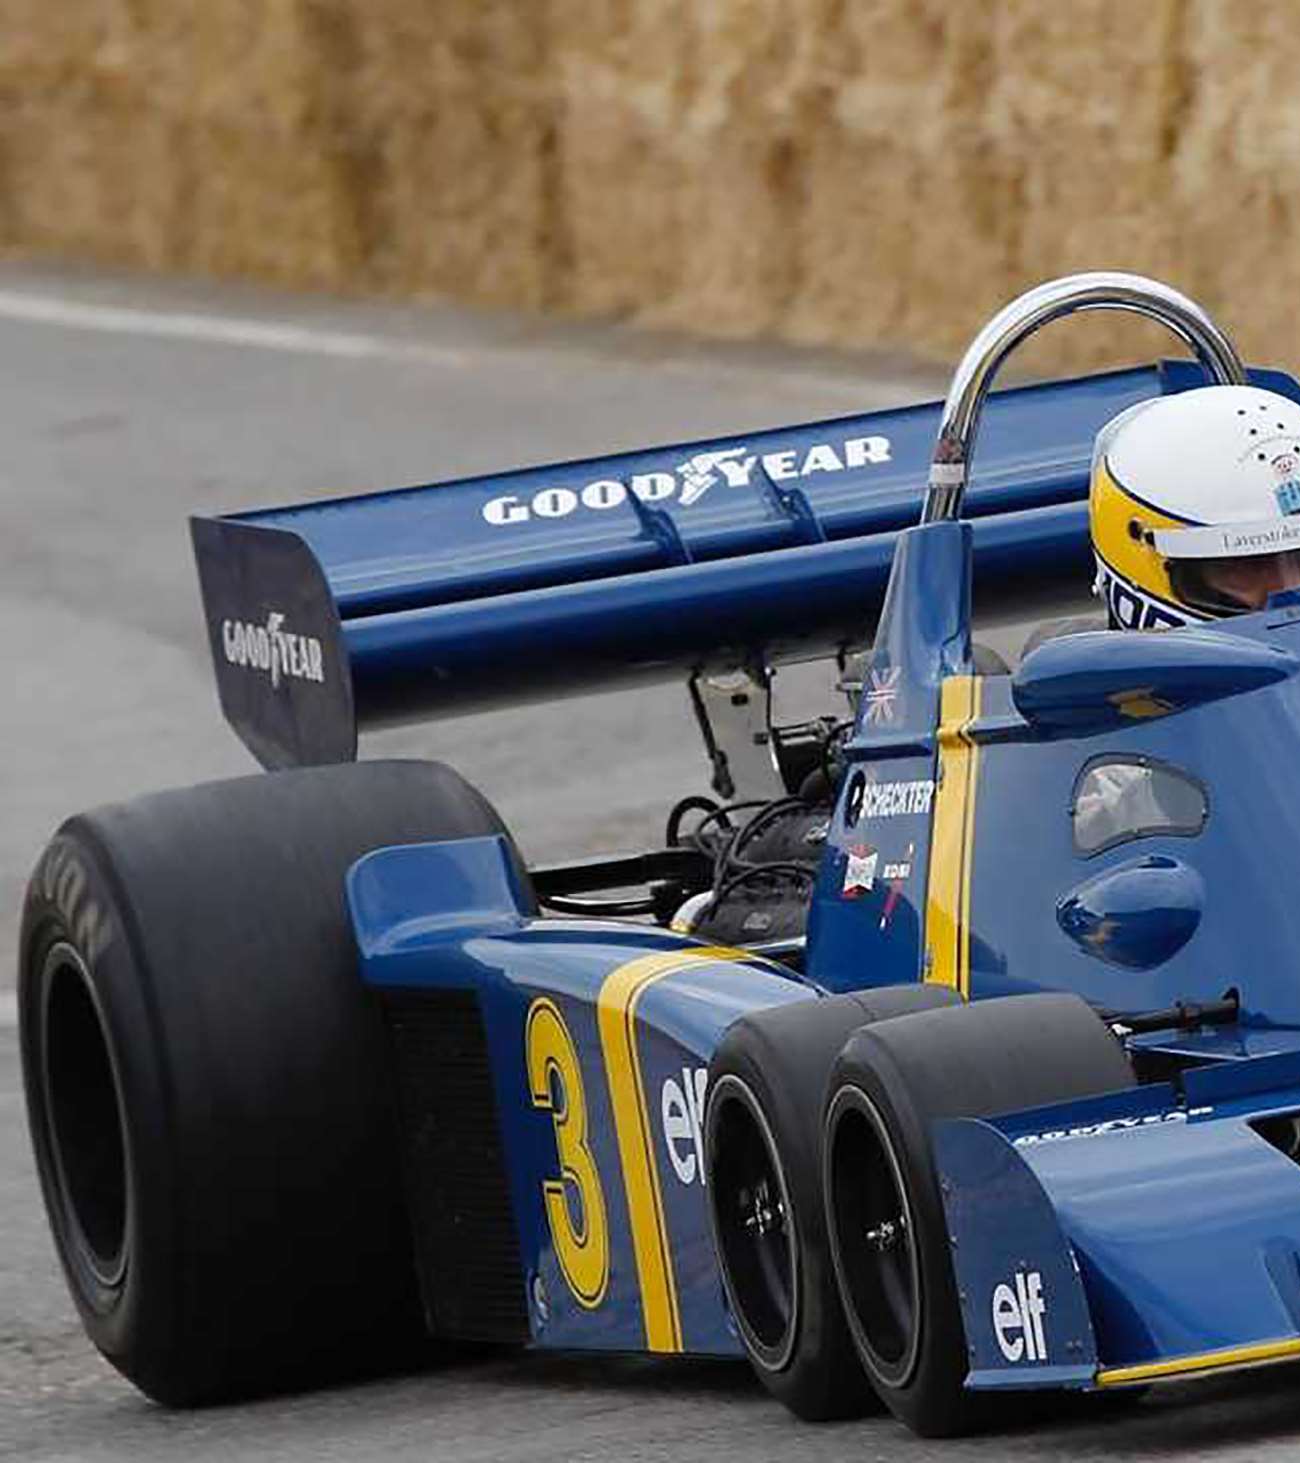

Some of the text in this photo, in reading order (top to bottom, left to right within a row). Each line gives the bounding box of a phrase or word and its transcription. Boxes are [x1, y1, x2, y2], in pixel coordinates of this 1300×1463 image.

[482, 435, 893, 525] GOODYEAR
[223, 611, 324, 688] GOODYEAR
[525, 996, 610, 1310] 3
[992, 1272, 1046, 1362] elf
